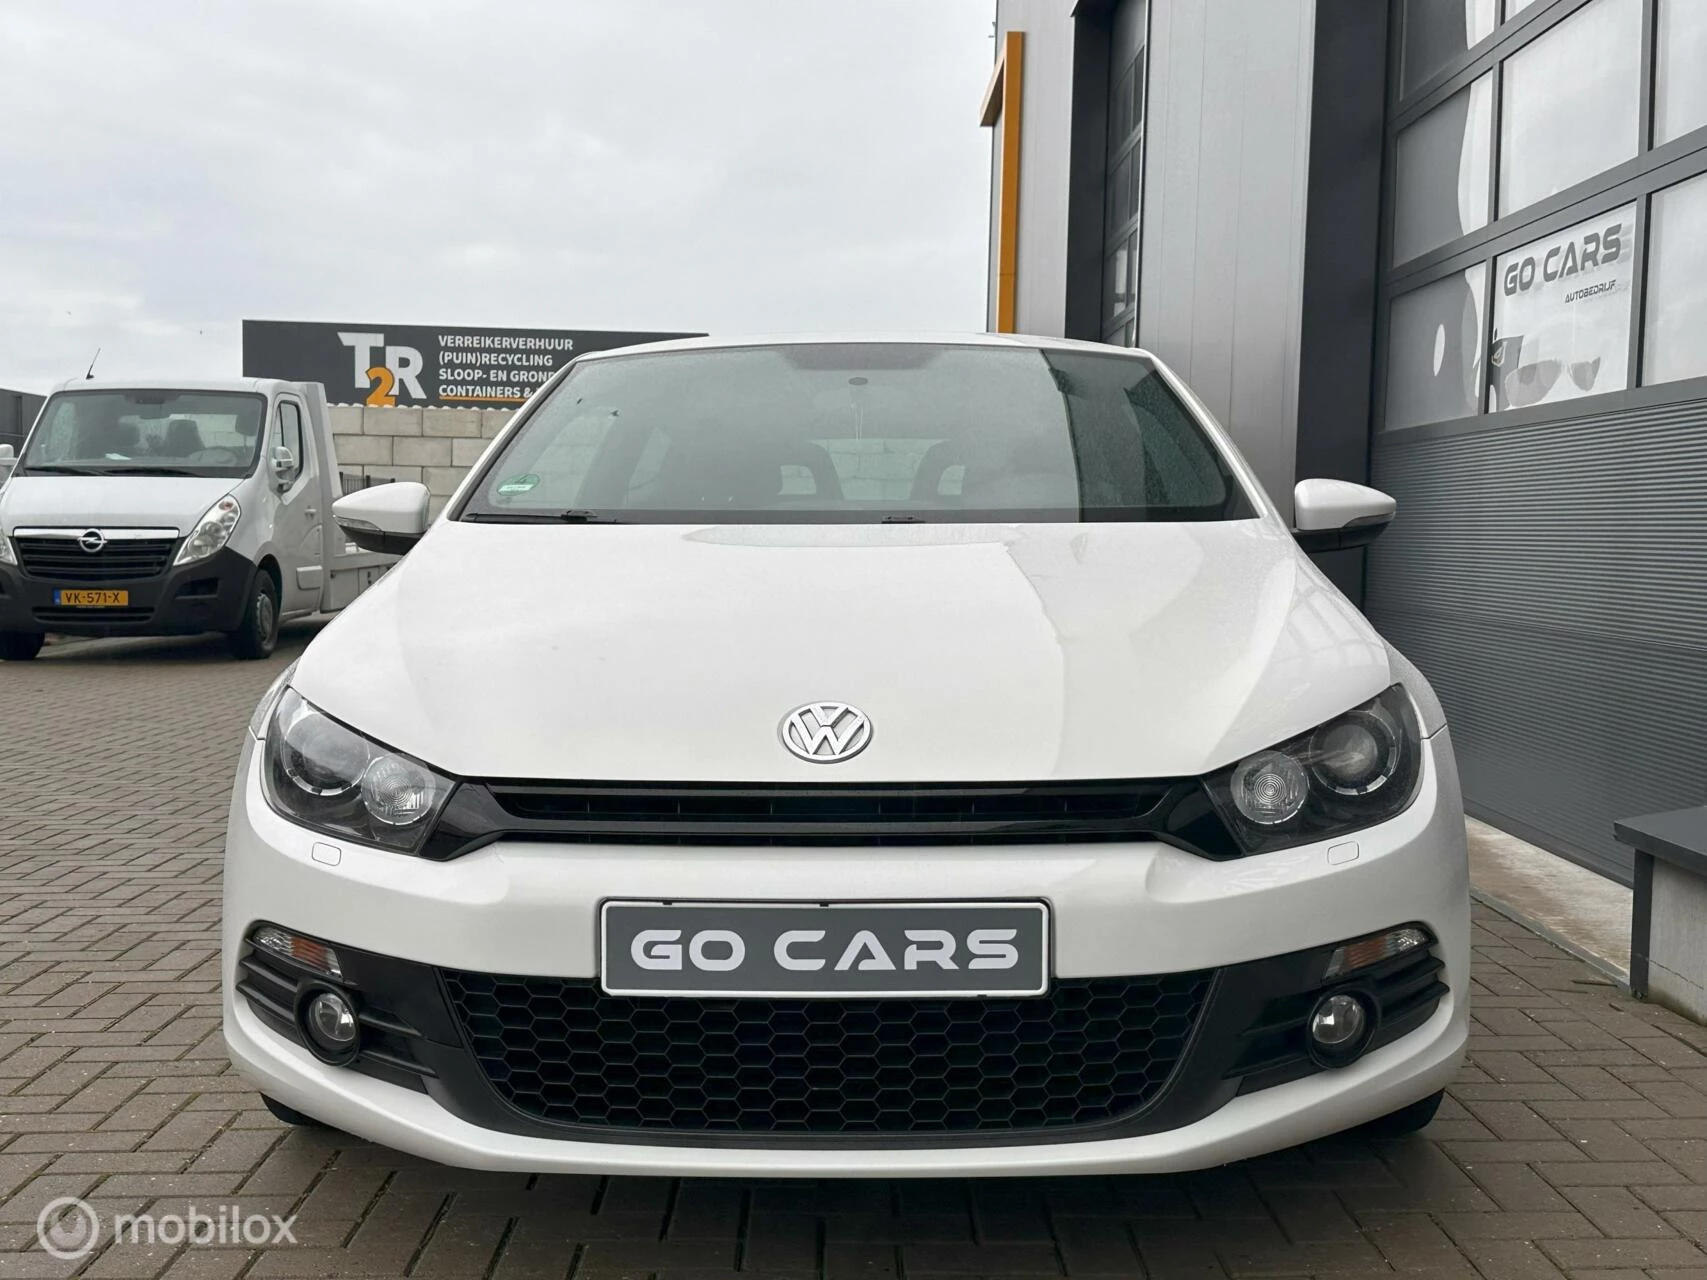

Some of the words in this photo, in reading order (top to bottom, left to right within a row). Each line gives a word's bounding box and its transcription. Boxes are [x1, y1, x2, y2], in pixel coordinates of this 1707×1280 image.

[1503, 256, 1536, 297] GO
[1543, 223, 1622, 283] CARS
[1564, 279, 1617, 304] AUTOBEDRIJF
[438, 335, 573, 350] VERREIKERVERHUUR
[438, 351, 553, 366] (PUIN)RECYCLING
[438, 368, 487, 381] SLOOP-
[490, 369, 507, 381] EN
[438, 385, 521, 398] CONTAINERS
[65, 592, 121, 604] VK-571-X
[630, 929, 746, 971] GO
[773, 928, 1019, 971] CARS
